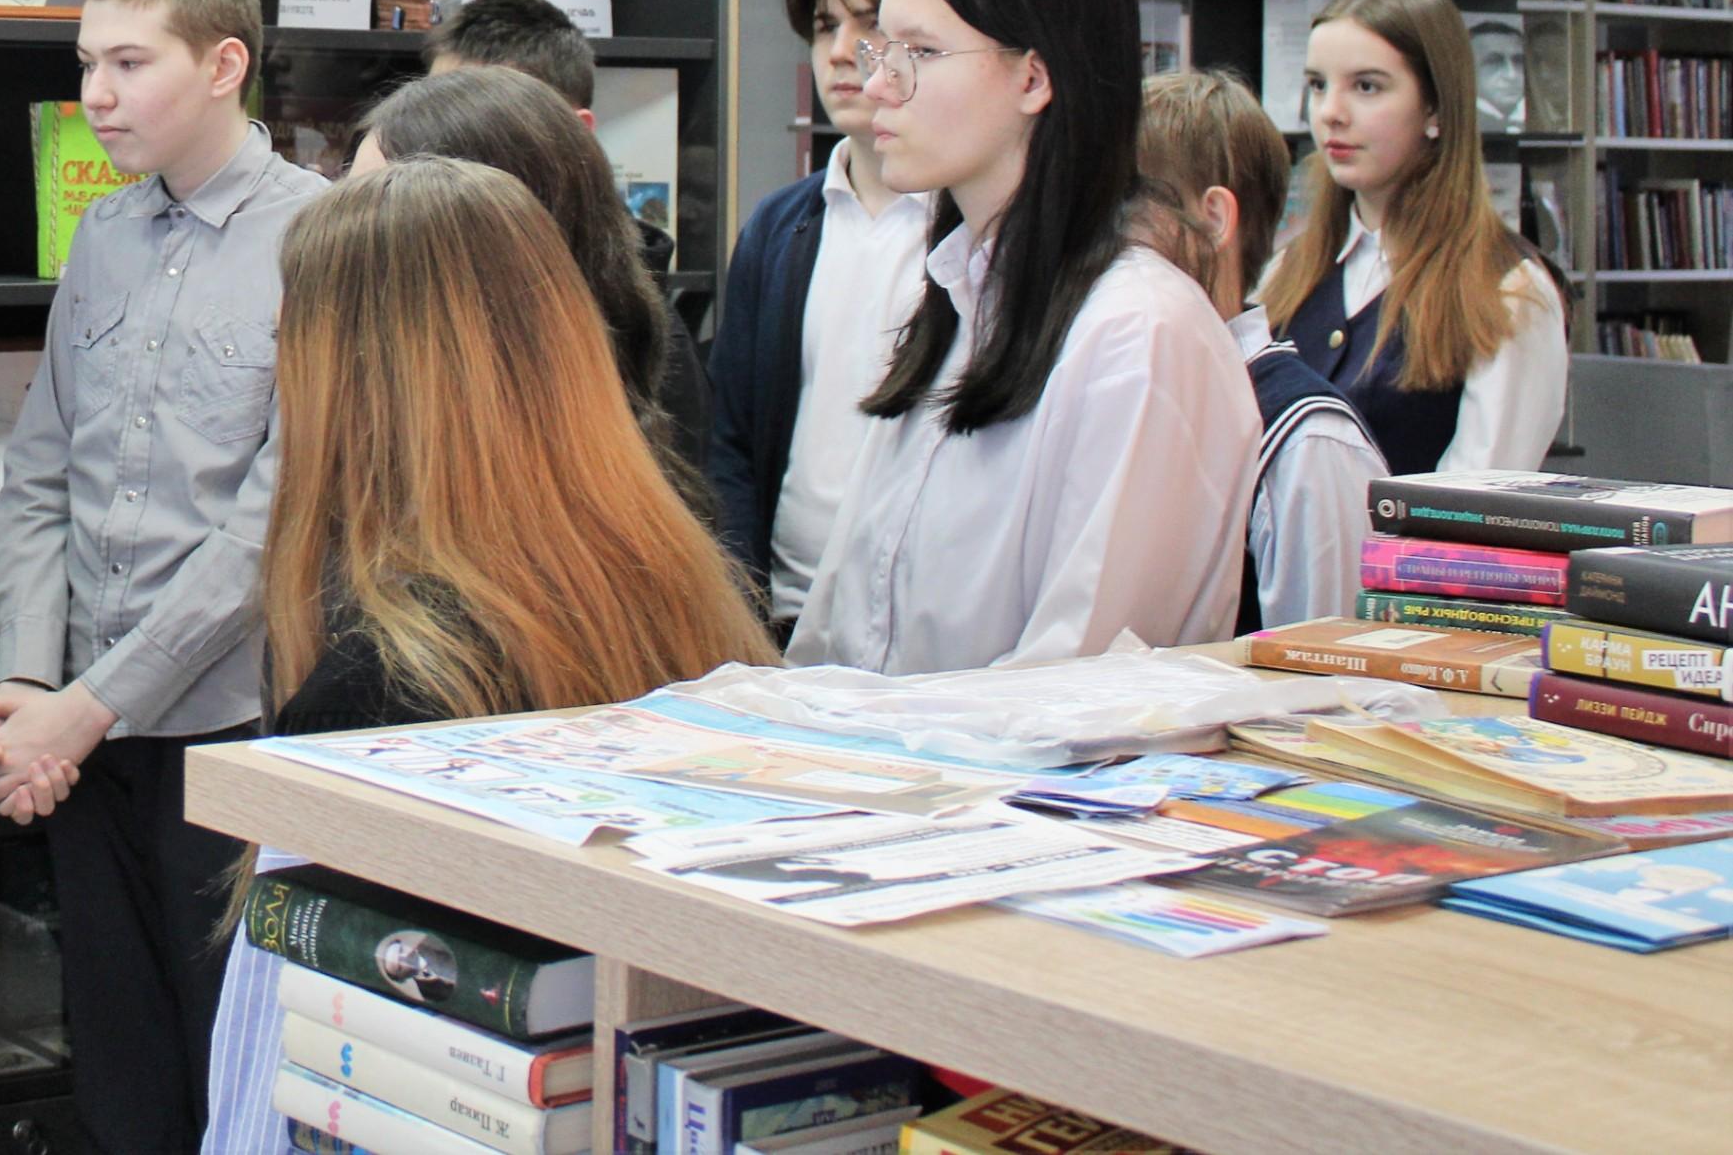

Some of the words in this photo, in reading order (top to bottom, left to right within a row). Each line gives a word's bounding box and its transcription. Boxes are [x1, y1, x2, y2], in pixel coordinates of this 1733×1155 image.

[1484, 514, 1560, 533] ПСИХОЛОГИЧЕСКАЯ
[1403, 603, 1429, 617] РЫБ
[1432, 607, 1537, 629] ПРЕСНОВОДНЫХ
[1580, 635, 1632, 656] КАРМА
[1285, 648, 1367, 672] Шантаж
[1585, 653, 1631, 672] БРАУН
[1648, 653, 1709, 669] РЕЦЕПТ
[1575, 697, 1616, 716] ЛИЗЗИ
[1621, 704, 1667, 726] ПЕЙДЖ
[289, 905, 301, 946] Малое
[449, 1098, 491, 1131] Пикар
